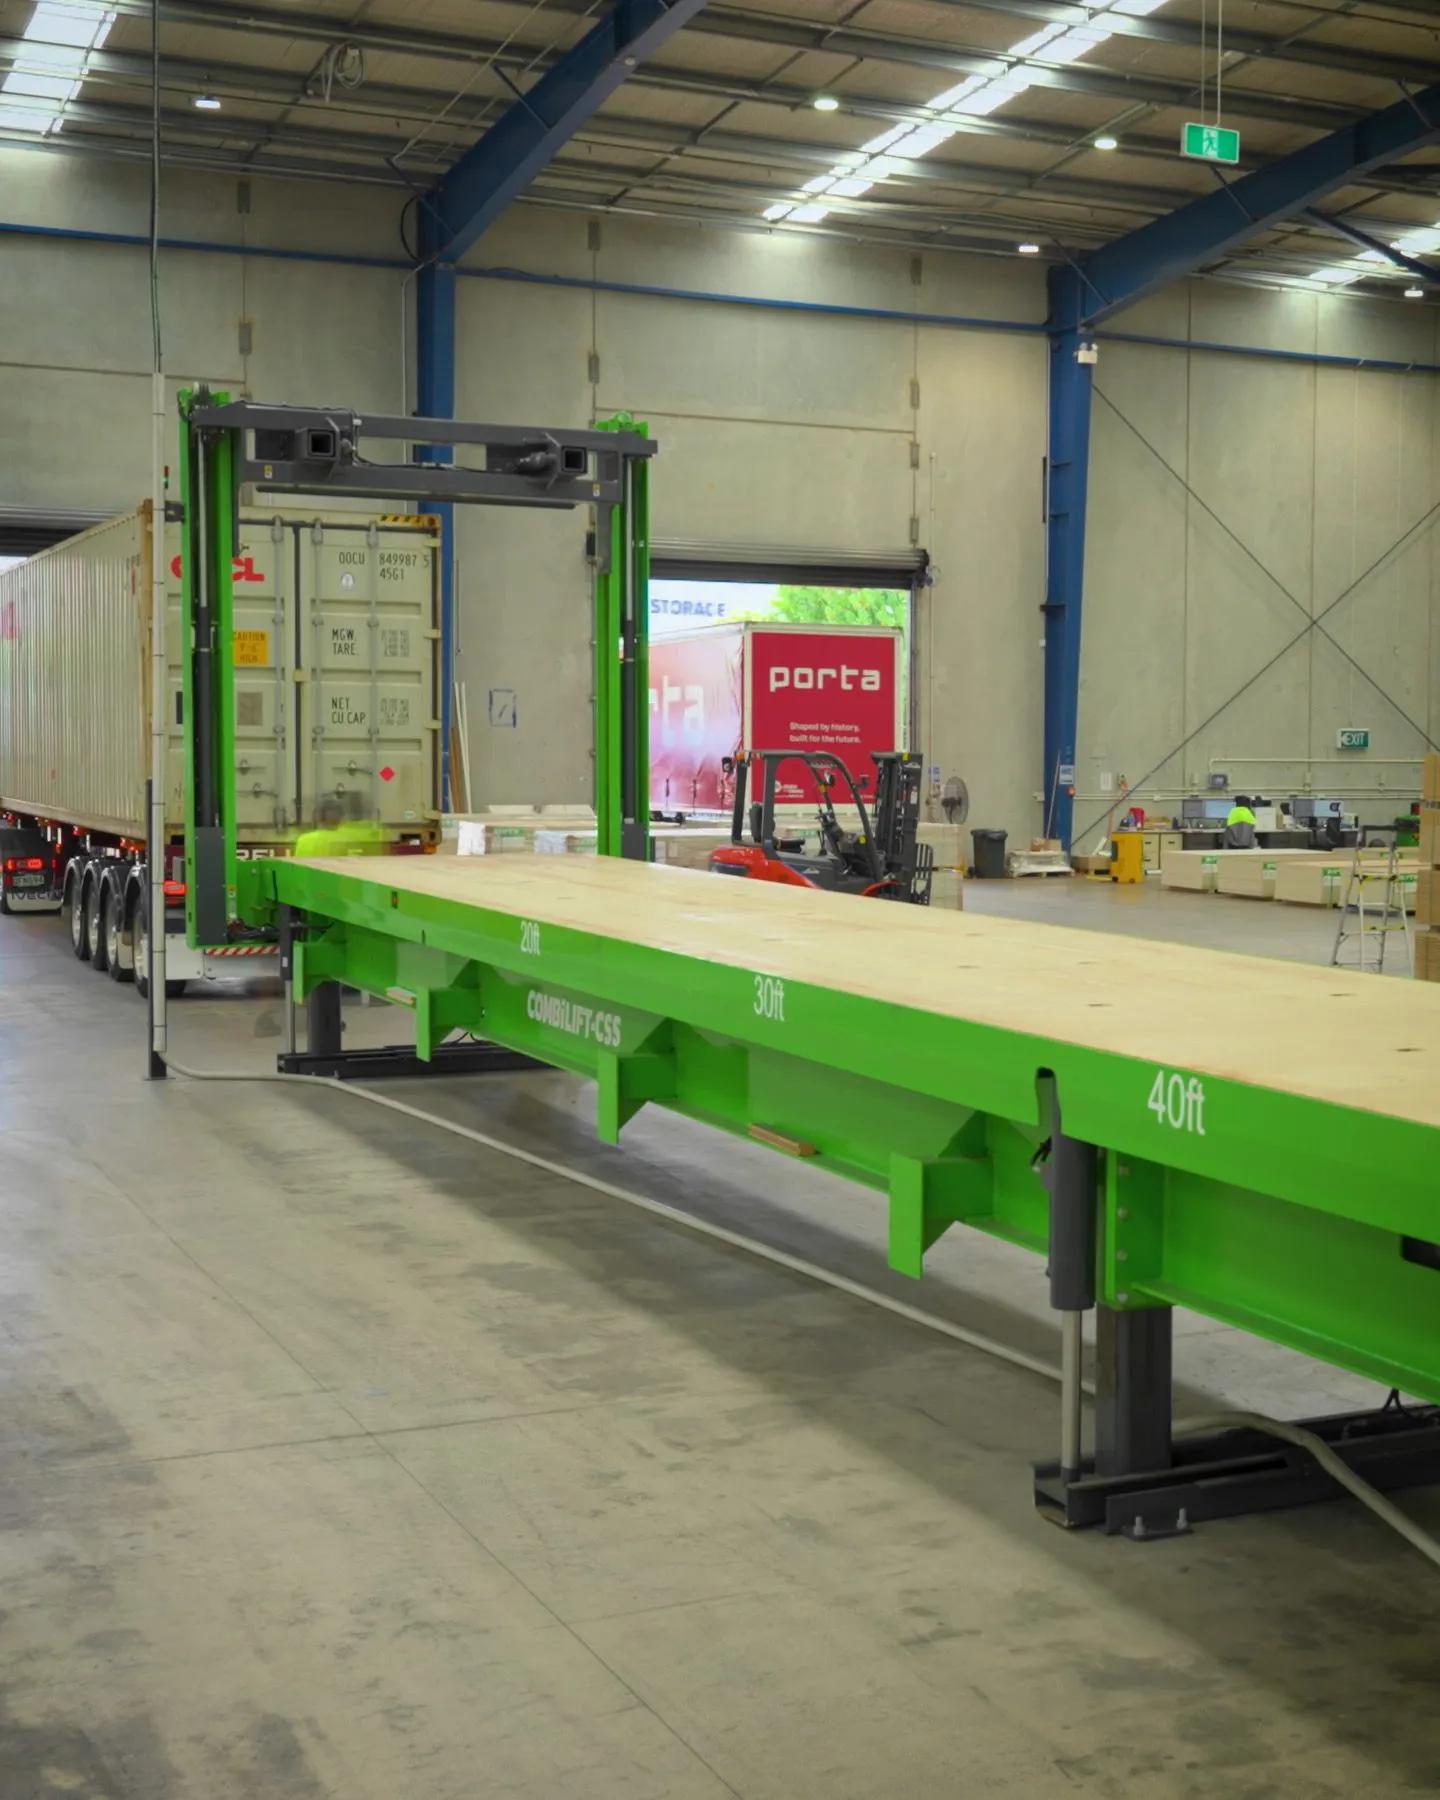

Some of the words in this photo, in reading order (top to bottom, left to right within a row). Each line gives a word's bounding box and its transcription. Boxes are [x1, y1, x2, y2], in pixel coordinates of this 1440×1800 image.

[338, 551, 365, 565] OOCU
[379, 552, 417, 567] 849987
[423, 554, 430, 568] 5
[379, 568, 404, 581] 45G1
[769, 664, 881, 692] porta
[332, 697, 350, 710] NET
[332, 711, 344, 724] CU
[346, 712, 366, 725] CAP
[789, 722, 818, 731] Shaped
[820, 723, 830, 733] by
[789, 735, 808, 743] built
[809, 735, 820, 743] for
[821, 735, 835, 743] the
[1343, 732, 1365, 746] EXIT
[520, 921, 540, 956] 20ft
[753, 975, 785, 1022] 30ft
[1147, 1069, 1206, 1136] 40ft
